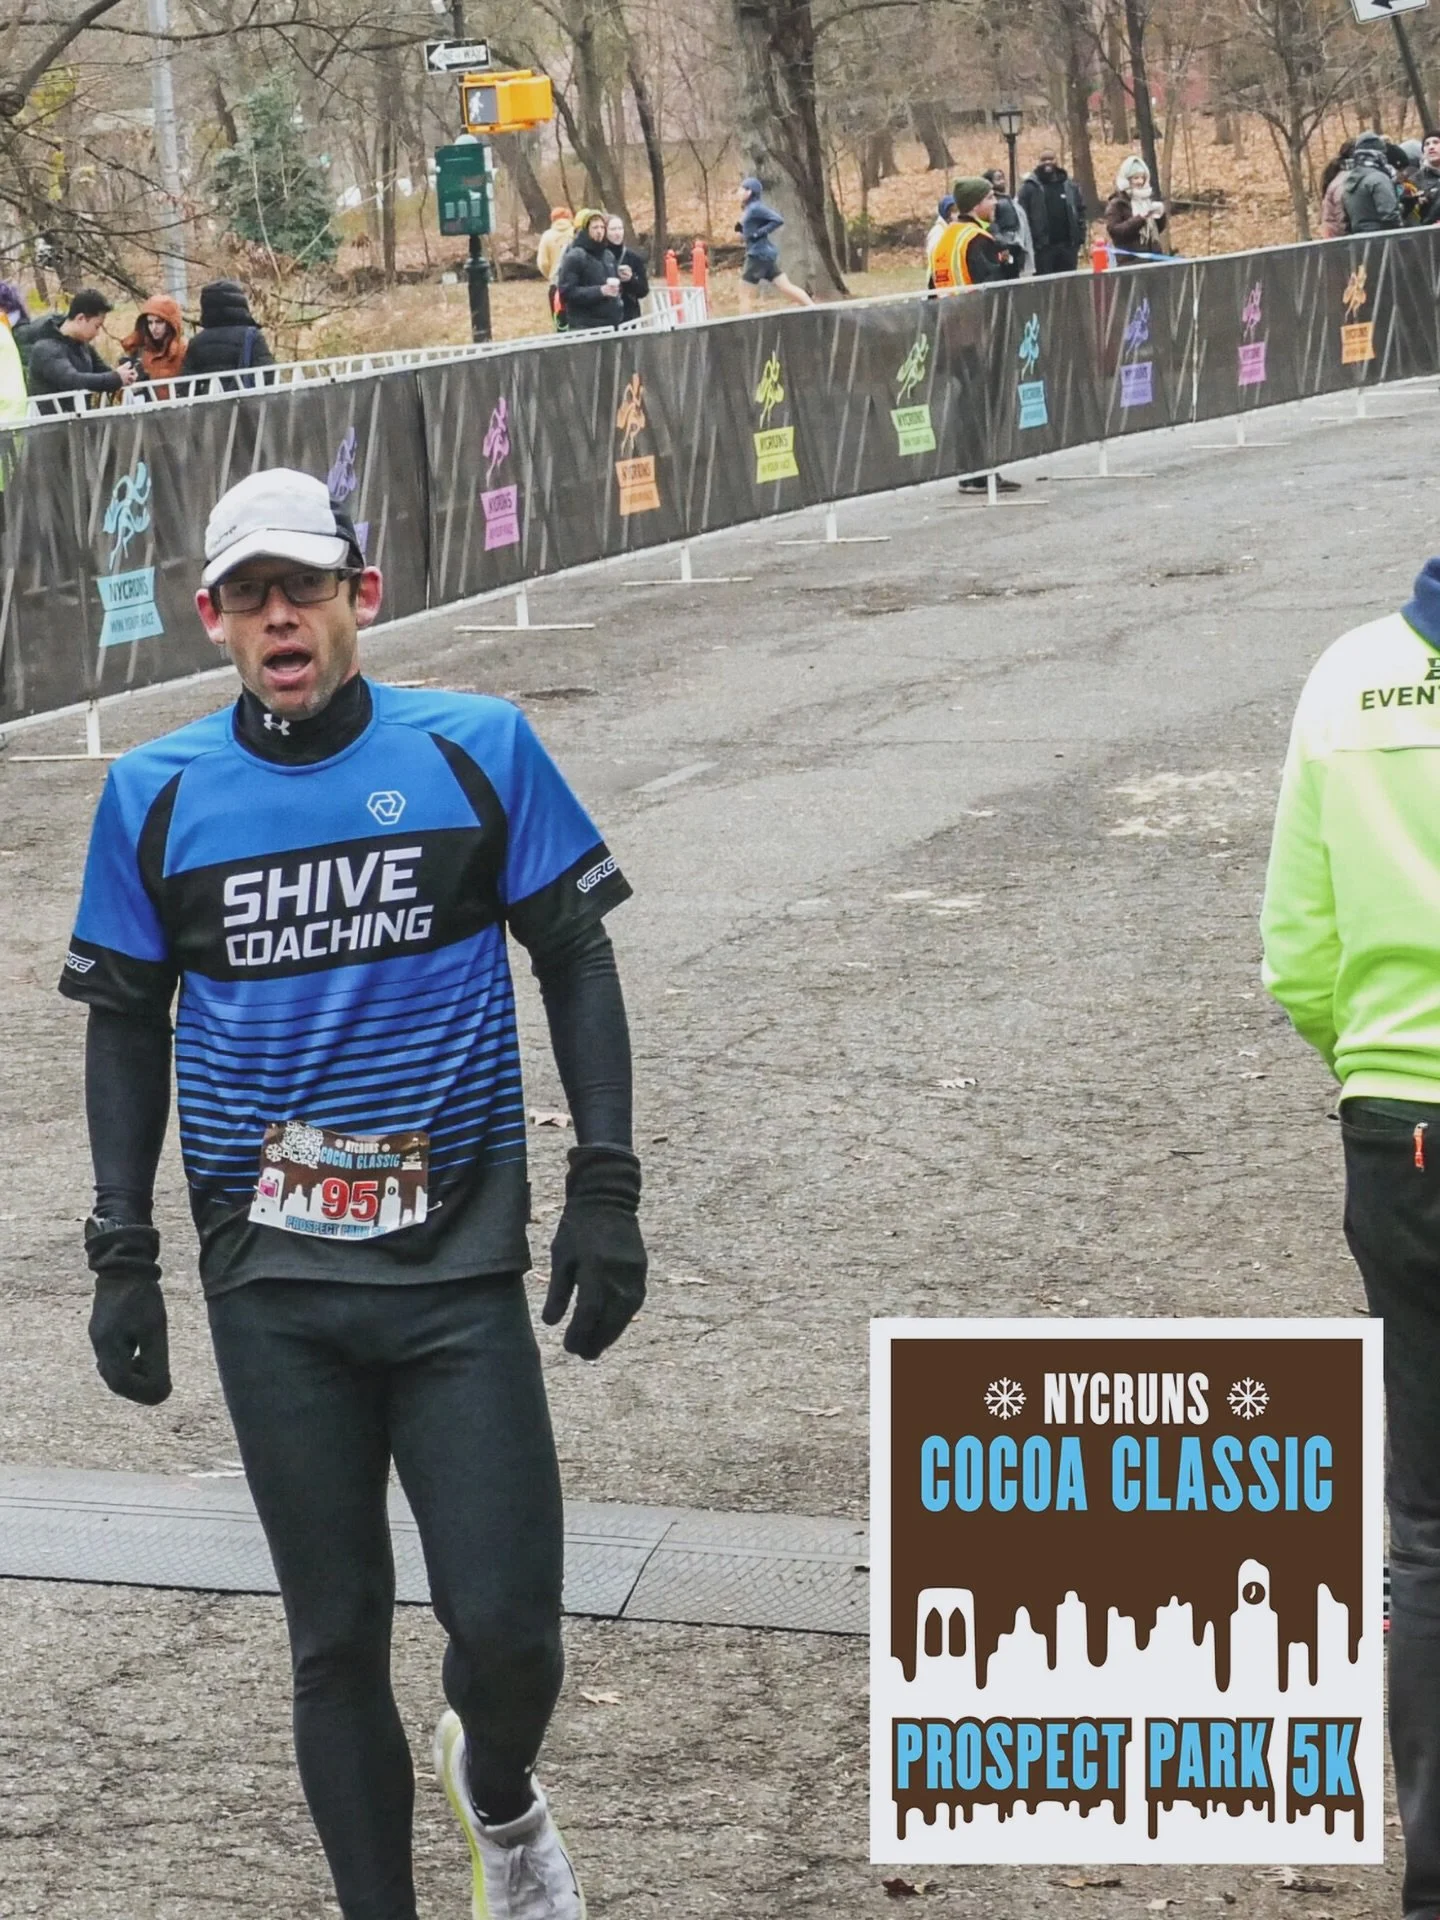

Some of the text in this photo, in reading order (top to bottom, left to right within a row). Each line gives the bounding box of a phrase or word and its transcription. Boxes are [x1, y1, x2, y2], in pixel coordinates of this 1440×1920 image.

[463, 47, 485, 60] WAY
[1361, 685, 1440, 711] EVEN
[223, 846, 423, 928] SHIVE
[576, 855, 617, 893] VERG
[225, 904, 435, 967] COACHING
[320, 1146, 401, 1170] COCOA CLASSIC
[321, 1177, 379, 1221] 95
[286, 1215, 339, 1236] PROSPECT
